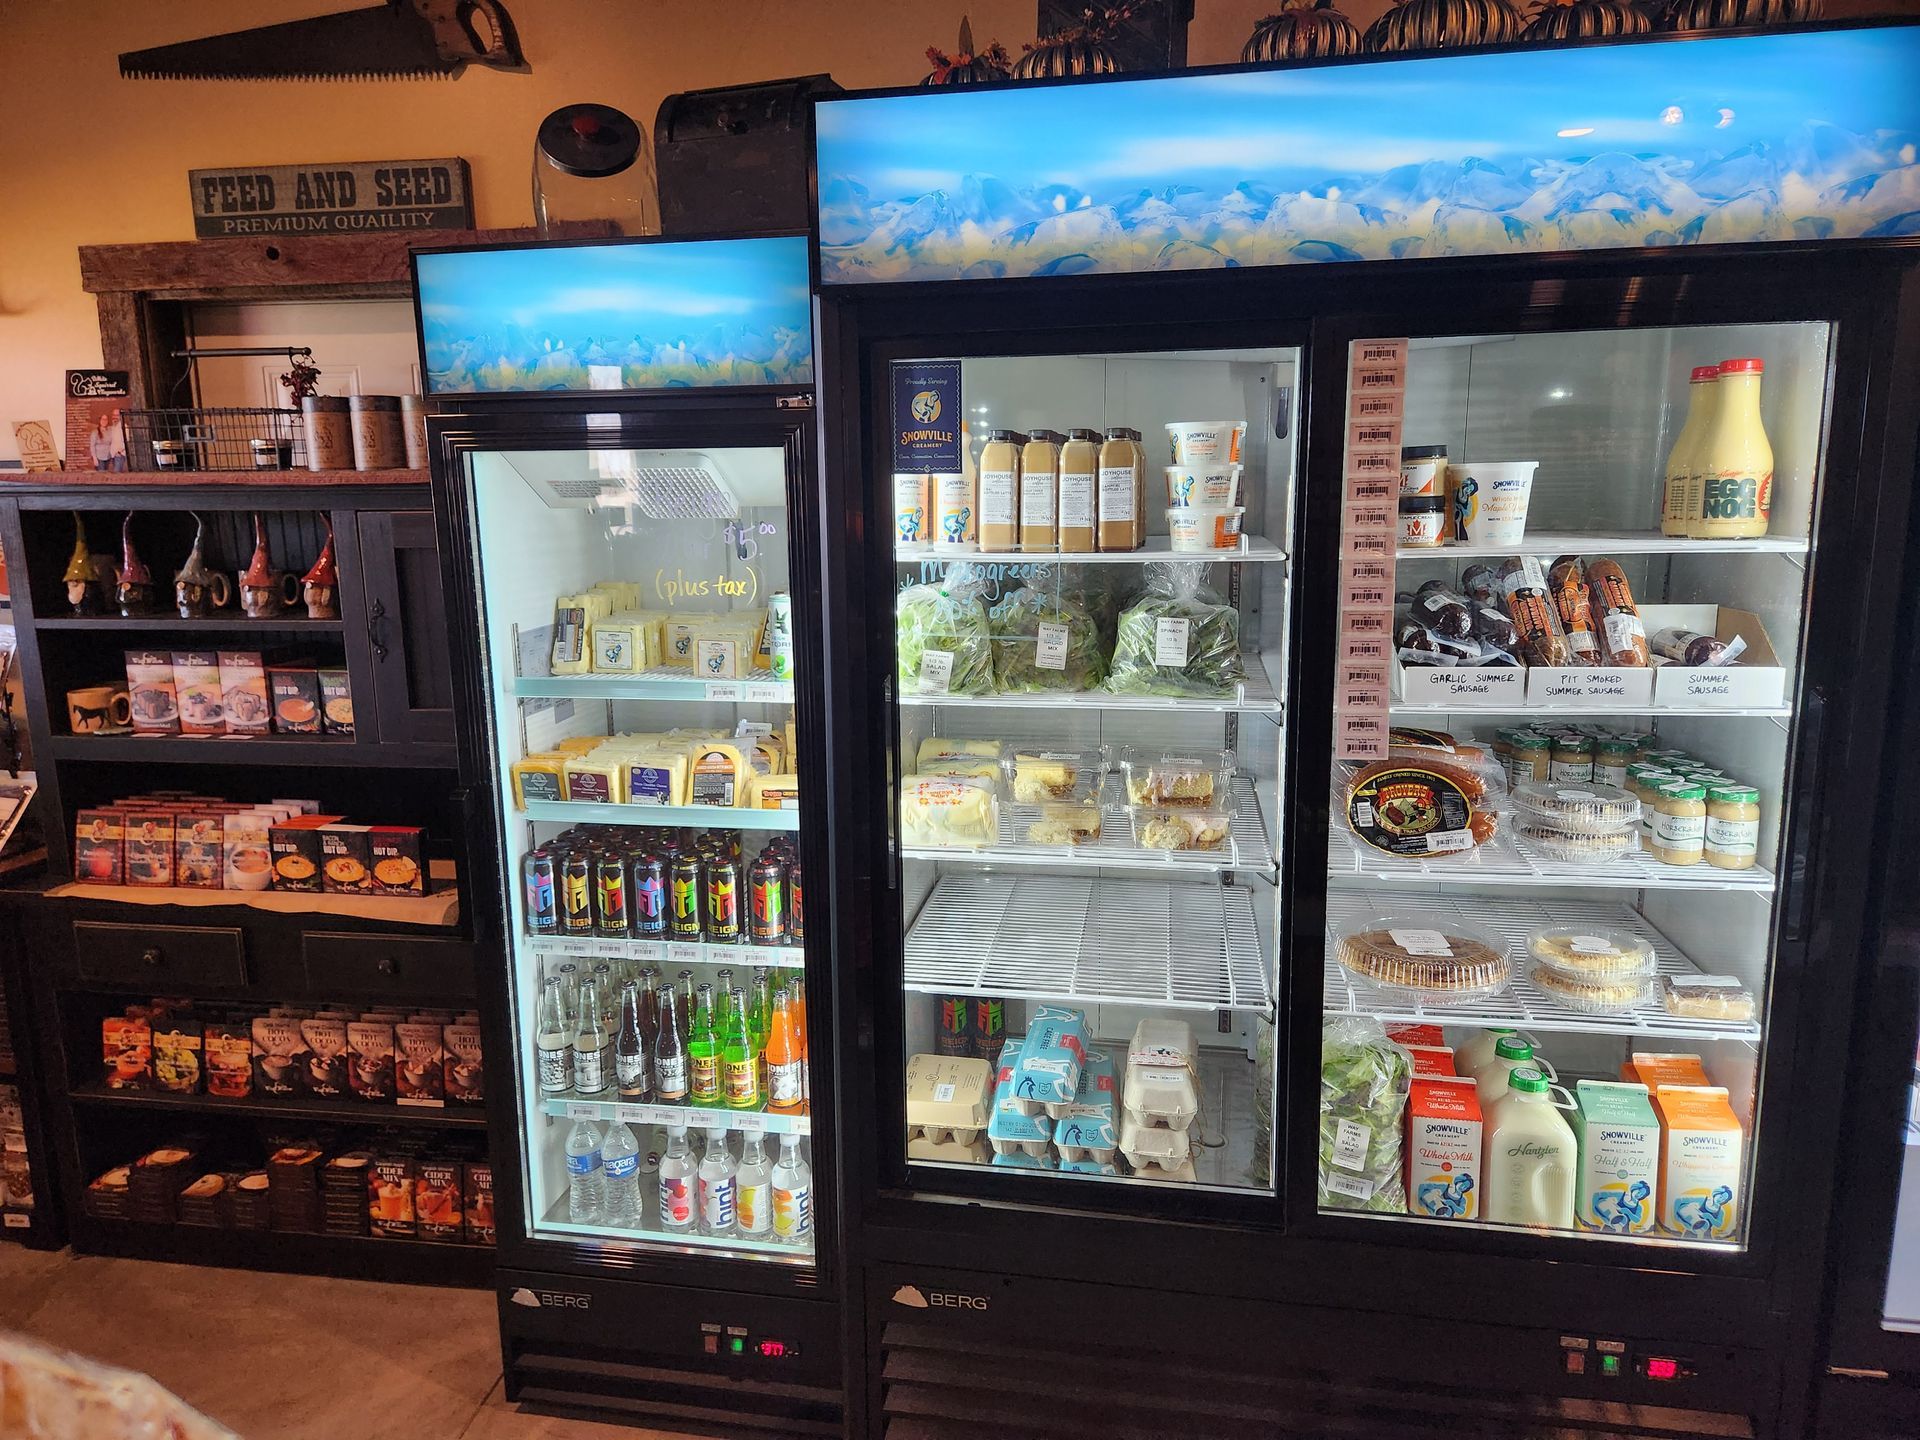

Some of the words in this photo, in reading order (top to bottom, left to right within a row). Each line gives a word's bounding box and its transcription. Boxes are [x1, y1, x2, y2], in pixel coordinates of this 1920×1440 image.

[201, 174, 275, 213] FEED
[295, 170, 356, 209] AND
[374, 166, 452, 207] SEED
[223, 215, 328, 233] PREMIUM
[334, 212, 434, 230] QUAILITY
[901, 430, 953, 446] SNOWVILLE
[1186, 432, 1216, 441] SNOWVILLE
[1704, 479, 1756, 499] EGG
[1703, 499, 1755, 518] NOG
[656, 568, 709, 605] (plus
[713, 566, 757, 606] tax)
[1430, 673, 1467, 684] GARLIC
[1476, 673, 1515, 683] SUMMER
[1561, 675, 1578, 684] PIT
[1586, 674, 1622, 684] SMOKED
[1688, 674, 1729, 683] SUMMER
[274, 686, 287, 695] HOT
[287, 686, 299, 695] DIP
[323, 686, 335, 696] HOT
[336, 686, 347, 696] DIP
[1450, 685, 1489, 694] SAUSAGE
[1545, 687, 1583, 696] SUMMER
[1588, 686, 1625, 695] SAUSAGE
[1688, 685, 1729, 695] SAUSAGE
[1385, 783, 1429, 800] TROYER'S
[273, 844, 285, 852] HOT
[286, 844, 298, 853] DIP
[323, 845, 336, 854] HOT
[336, 846, 348, 855] DIP
[373, 847, 386, 856] HOT
[387, 847, 399, 856] DIP
[708, 923, 739, 933] REIGN
[1426, 1101, 1449, 1110] Whole
[1449, 1103, 1466, 1112] Milk
[1343, 1129, 1361, 1137] FARMS
[1426, 1124, 1468, 1136] SNOWVILLE
[1601, 1130, 1644, 1142] SNOWVILLE
[1683, 1136, 1727, 1147] SNOWVILLE
[1342, 1140, 1359, 1148] SALAD
[1419, 1147, 1453, 1161] Whole
[1453, 1148, 1473, 1162] Milk
[603, 1156, 636, 1170] niagara
[1594, 1154, 1618, 1168] Half
[1628, 1156, 1652, 1169] Half
[377, 1166, 404, 1176] CIDER
[424, 1171, 452, 1180] CIDER
[382, 1174, 400, 1183] MIX
[429, 1178, 448, 1187] MIX
[715, 1185, 732, 1226] hint
[796, 1187, 810, 1233] hint
[541, 1293, 589, 1309] BERG
[930, 1292, 988, 1310] BERG
